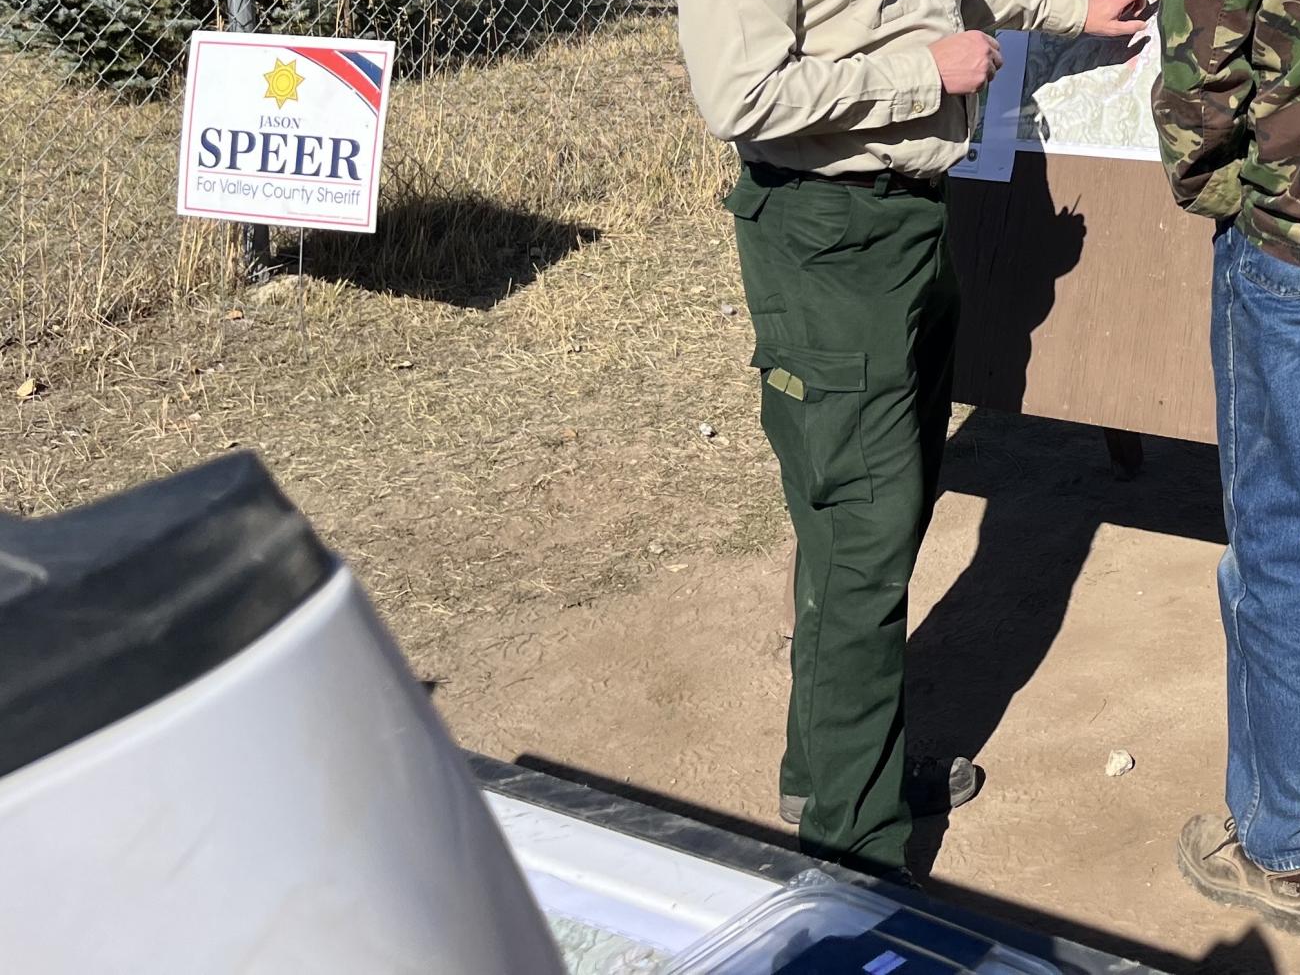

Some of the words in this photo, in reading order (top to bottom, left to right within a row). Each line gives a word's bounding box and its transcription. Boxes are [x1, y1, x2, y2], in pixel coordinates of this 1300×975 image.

[259, 115, 302, 129] JASON
[198, 127, 362, 181] SPEER
[197, 176, 217, 192] For
[219, 179, 259, 200] Valley
[262, 182, 314, 205] County
[317, 187, 361, 205] Sheriff
